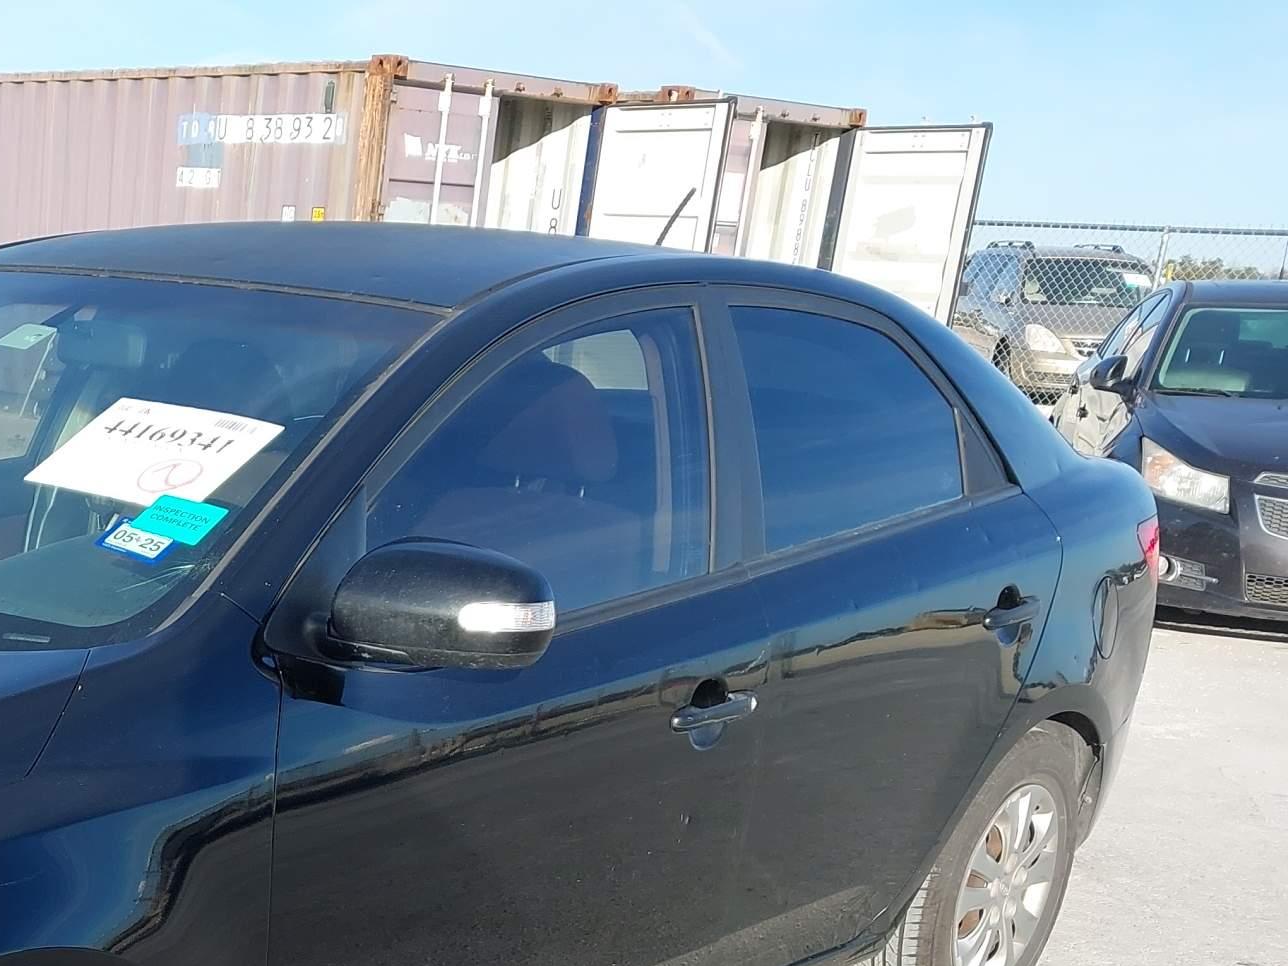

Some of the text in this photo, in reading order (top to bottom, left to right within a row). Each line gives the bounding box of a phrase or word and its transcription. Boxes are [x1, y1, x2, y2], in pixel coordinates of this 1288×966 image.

[104, 418, 235, 454] 44169341
[150, 513, 202, 532] COMPLETE
[153, 505, 211, 525] INSPECTION
